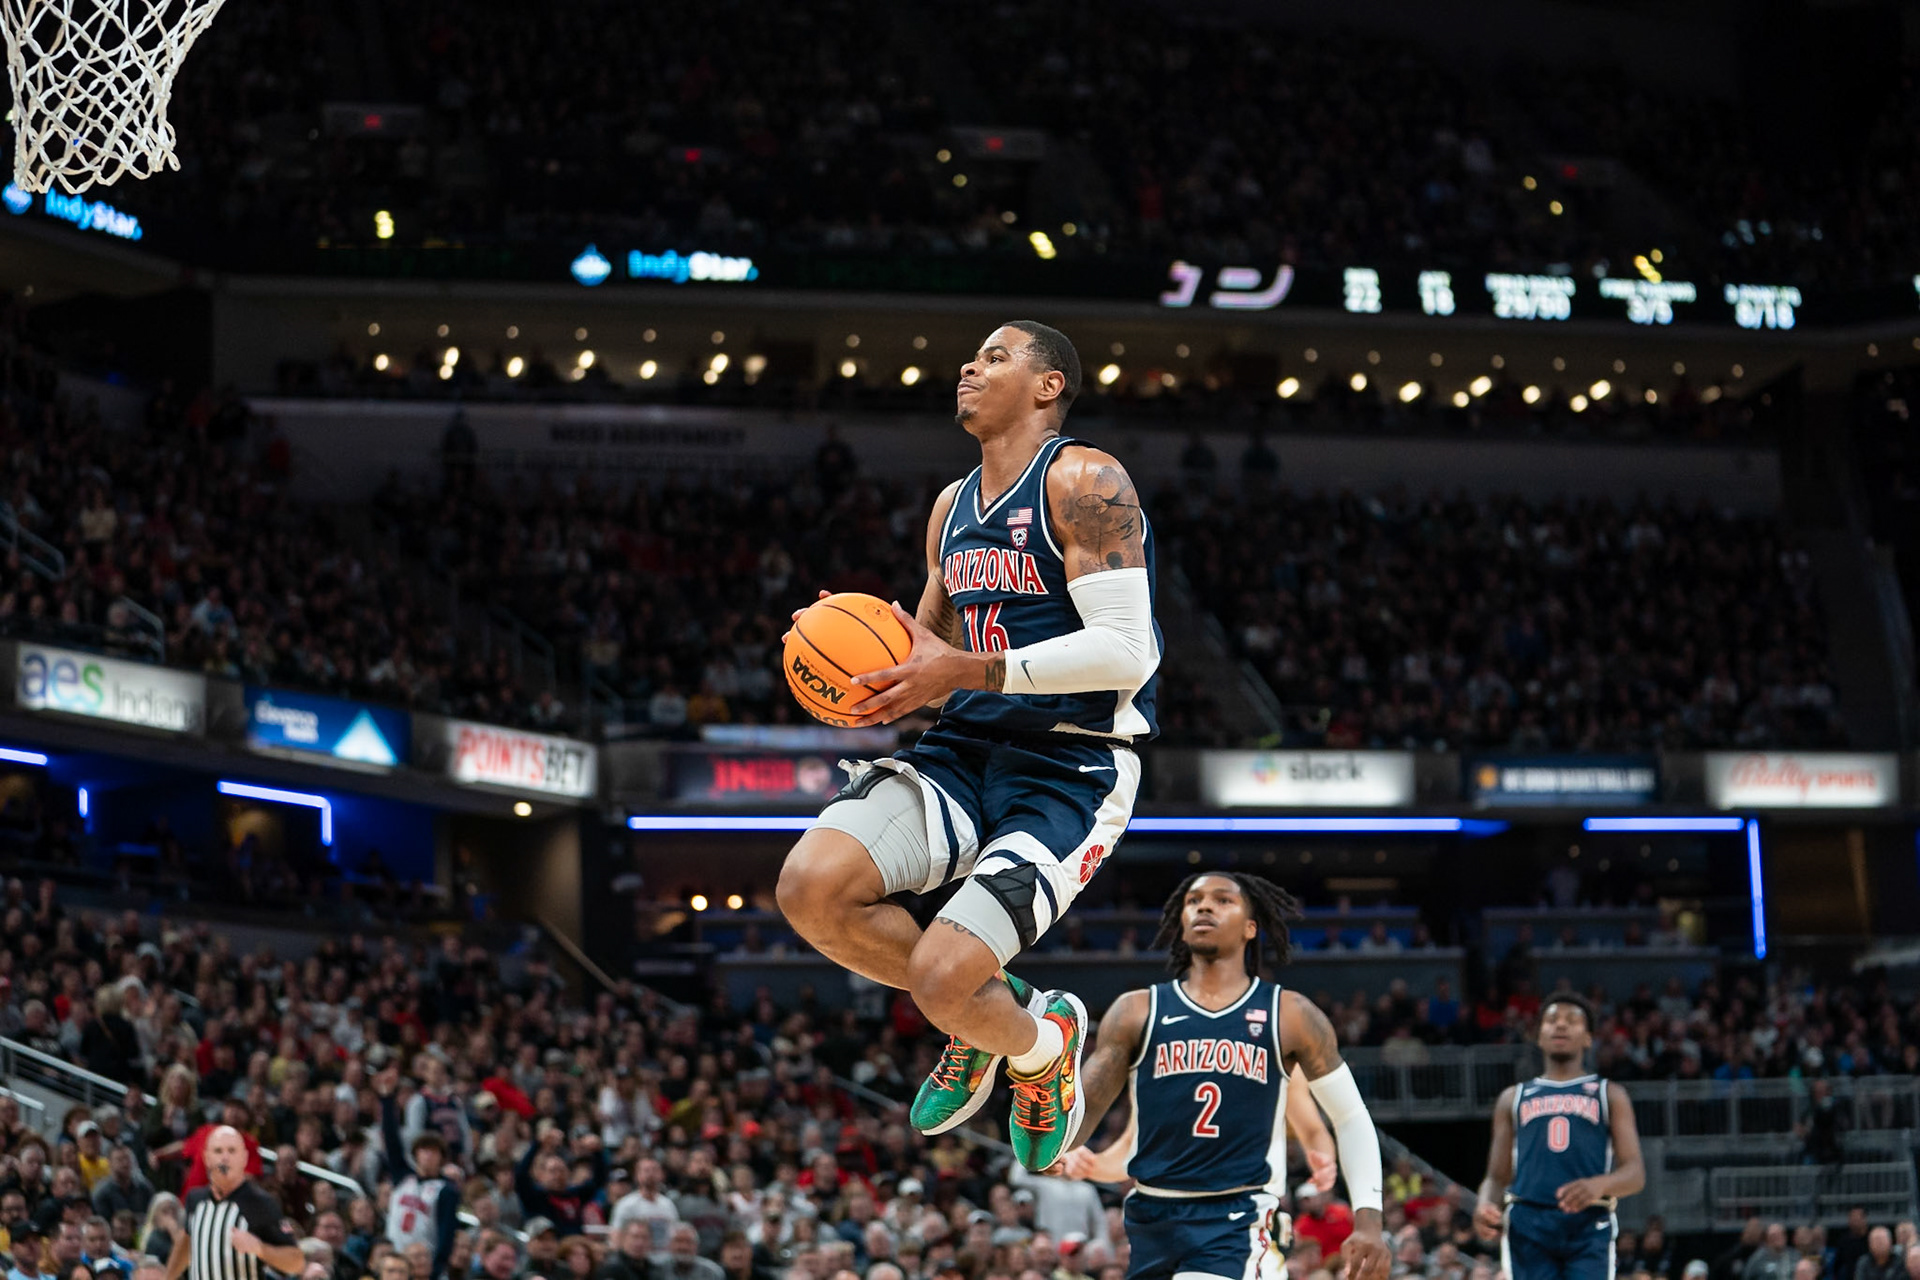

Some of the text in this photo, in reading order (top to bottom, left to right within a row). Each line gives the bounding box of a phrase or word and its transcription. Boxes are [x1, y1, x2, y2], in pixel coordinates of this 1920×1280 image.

[944, 547, 1049, 597] ARIZONA
[965, 602, 1010, 653] 16
[22, 653, 104, 715] aes
[792, 655, 846, 704] NCAA
[1153, 1039, 1268, 1084] ARIZONA
[1192, 1081, 1222, 1138] 2
[1520, 1094, 1599, 1127] ARIZONA
[1548, 1115, 1570, 1153] 0
